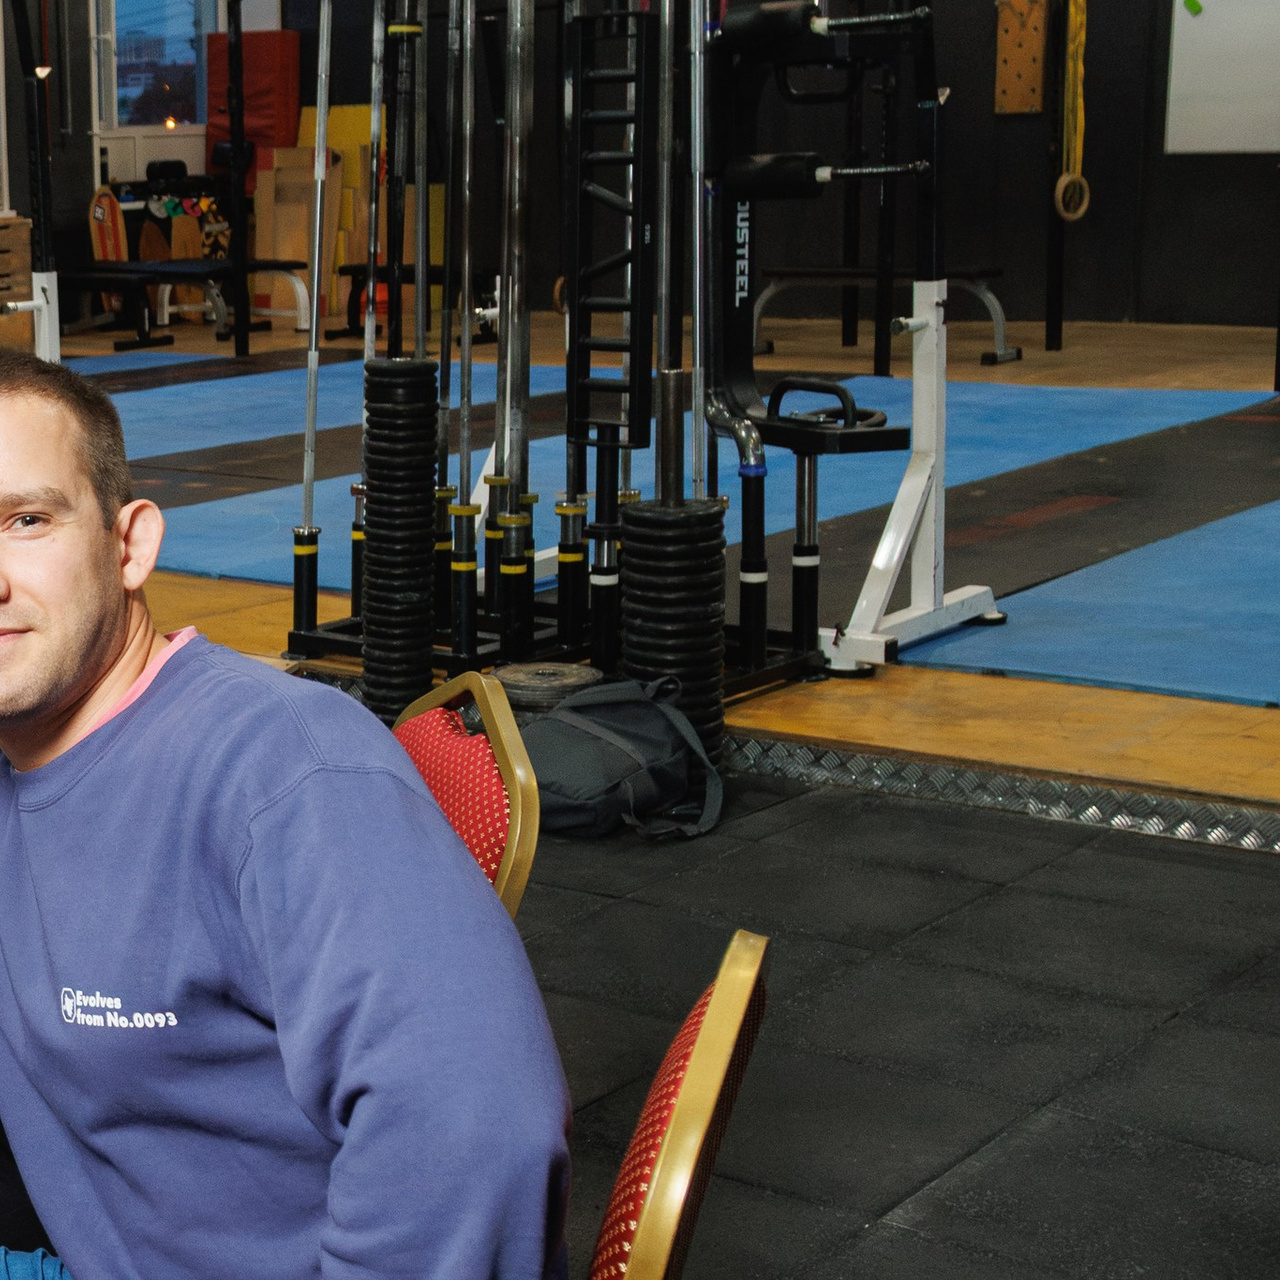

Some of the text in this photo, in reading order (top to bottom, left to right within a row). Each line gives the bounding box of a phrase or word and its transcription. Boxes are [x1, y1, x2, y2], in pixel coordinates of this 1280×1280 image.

[735, 201, 750, 308] OUSTEEL
[76, 991, 122, 1009] Evolves
[76, 1008, 178, 1028] from No.0093
